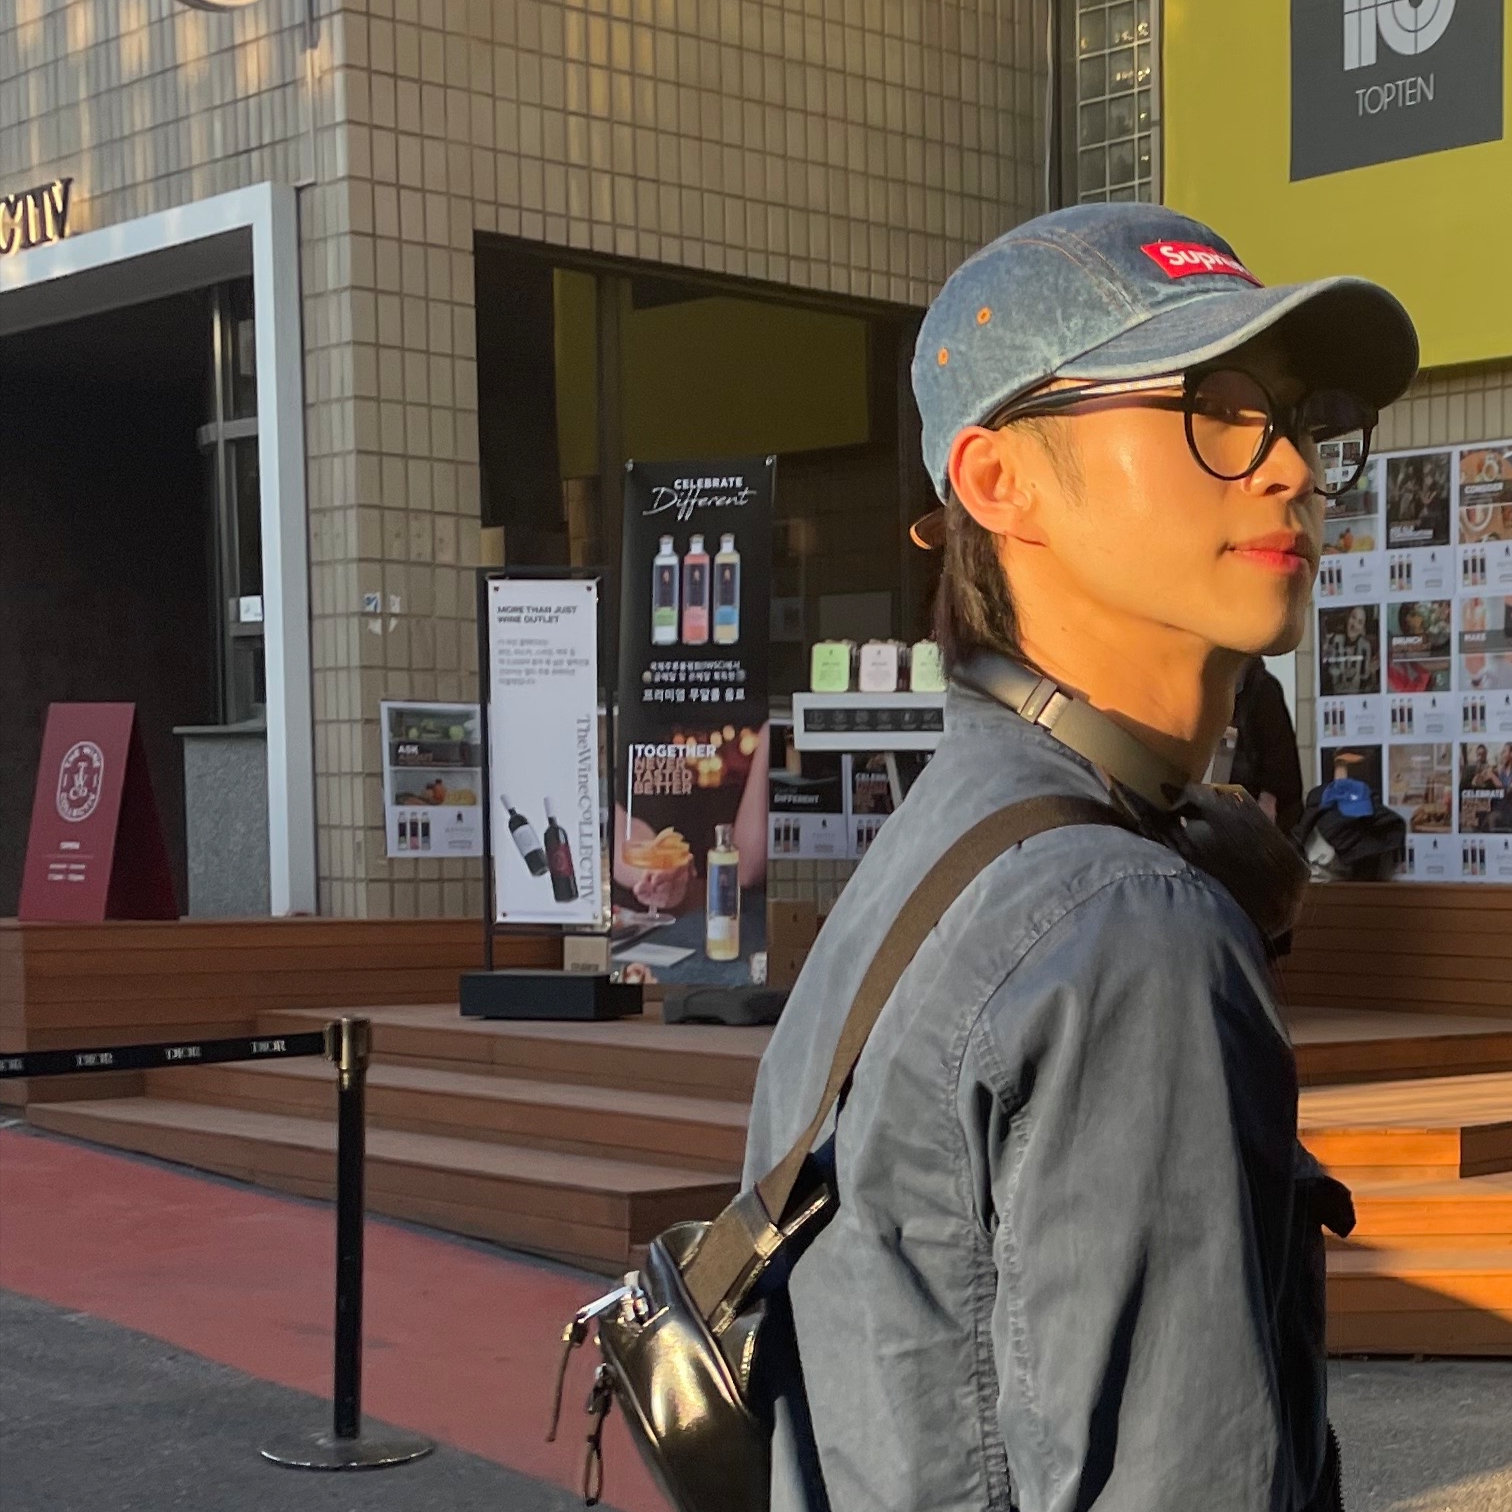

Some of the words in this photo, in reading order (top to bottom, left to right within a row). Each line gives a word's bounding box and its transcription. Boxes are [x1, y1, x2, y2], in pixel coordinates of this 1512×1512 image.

[1355, 72, 1435, 117] TOPTEN
[674, 477, 743, 490] CELEBRATE
[643, 487, 757, 521] Different
[497, 605, 524, 614] MORE
[526, 605, 552, 614] THAN
[553, 605, 578, 614] JUST
[497, 615, 521, 624] WINE
[523, 615, 559, 624] OUTLET
[642, 688, 686, 702] 프리미엄
[724, 687, 746, 702] 음료
[398, 744, 420, 755] ASK
[634, 744, 717, 758] TOGETHER
[634, 757, 687, 771] NEVER
[634, 769, 693, 782] TASTED
[633, 781, 693, 795] BETTER
